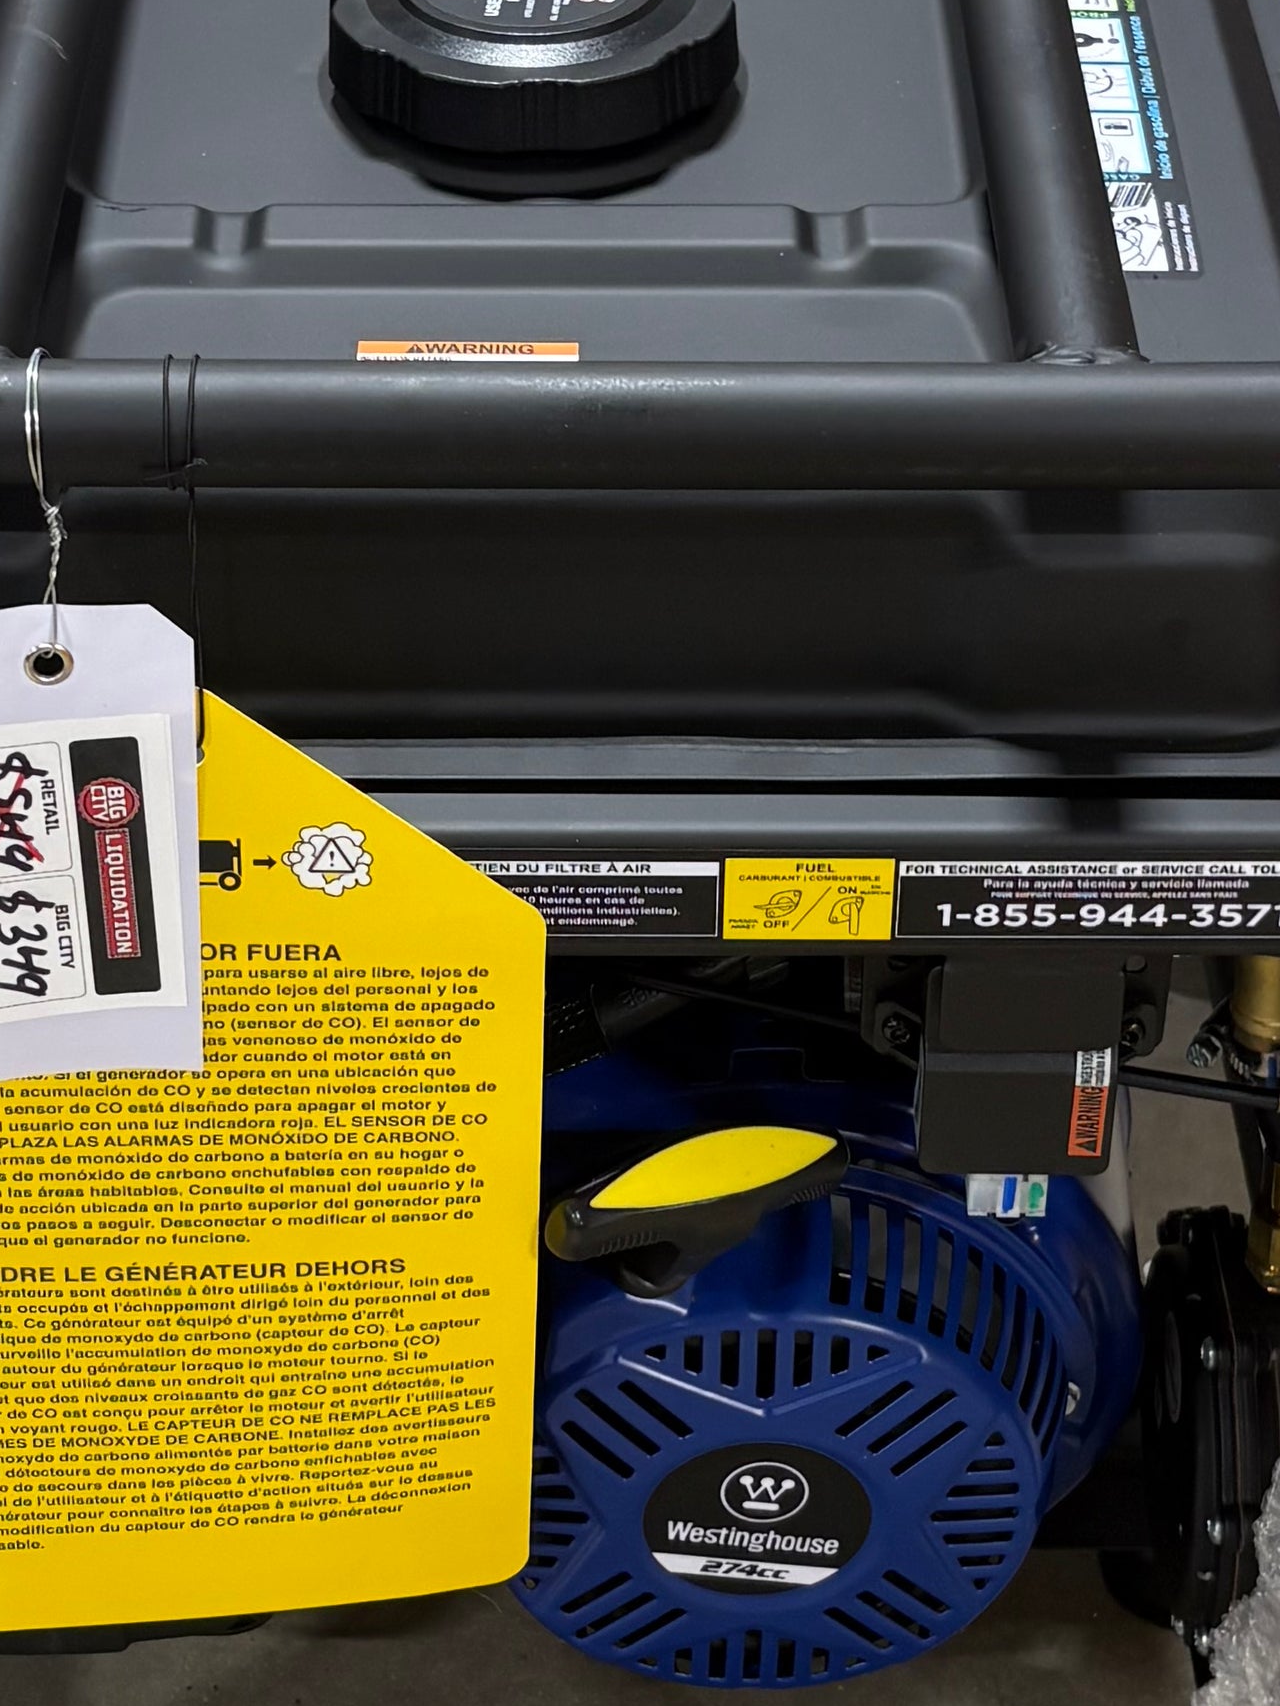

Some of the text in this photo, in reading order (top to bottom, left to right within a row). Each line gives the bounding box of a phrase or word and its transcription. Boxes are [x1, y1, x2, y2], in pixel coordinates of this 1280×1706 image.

[1129, 15, 1173, 179] Inicio de gasolina Début de l'essence
[426, 344, 534, 354] WARNING
[40, 779, 60, 836] RETAIL
[89, 784, 109, 822] CITY
[107, 786, 127, 819] BIG
[516, 861, 651, 873] DU FILTRE À AIR
[796, 863, 835, 873] FUEL
[905, 864, 934, 873] FOR
[940, 865, 1022, 874] TECHNICAL
[1027, 865, 1116, 873] ASSISTANCE
[1141, 865, 1203, 874] SERVICE
[1209, 865, 1245, 873] CALL
[838, 886, 858, 895] ON
[983, 878, 1249, 889] Para la ayuda técnica y servicio llamada
[105, 833, 132, 954] LIQUIDATION
[539, 896, 581, 904] heures
[628, 896, 644, 904] de
[558, 917, 634, 926] endommagé.
[763, 920, 790, 929] OFF
[55, 905, 75, 968] BIG CITY
[247, 943, 341, 960] FUERA
[1075, 1087, 1104, 1139] WARNING
[63, 1135, 98, 1147] LAS
[103, 1134, 193, 1146] ALARMAS
[199, 1134, 223, 1145] DE
[229, 1131, 327, 1145] MONÓXIDO
[334, 1132, 357, 1143] DE
[363, 1130, 458, 1143] CARBONO.
[33, 1235, 47, 1245] el
[53, 1234, 139, 1247] generador
[145, 1235, 166, 1244] no
[171, 1232, 249, 1243] funcione.
[64, 1266, 96, 1282] LE
[105, 1262, 285, 1281] GÉNÉRATEUR
[295, 1258, 405, 1276] DEHORS
[668, 1520, 839, 1555] Westinghouse
[700, 1559, 790, 1580] 274cc
